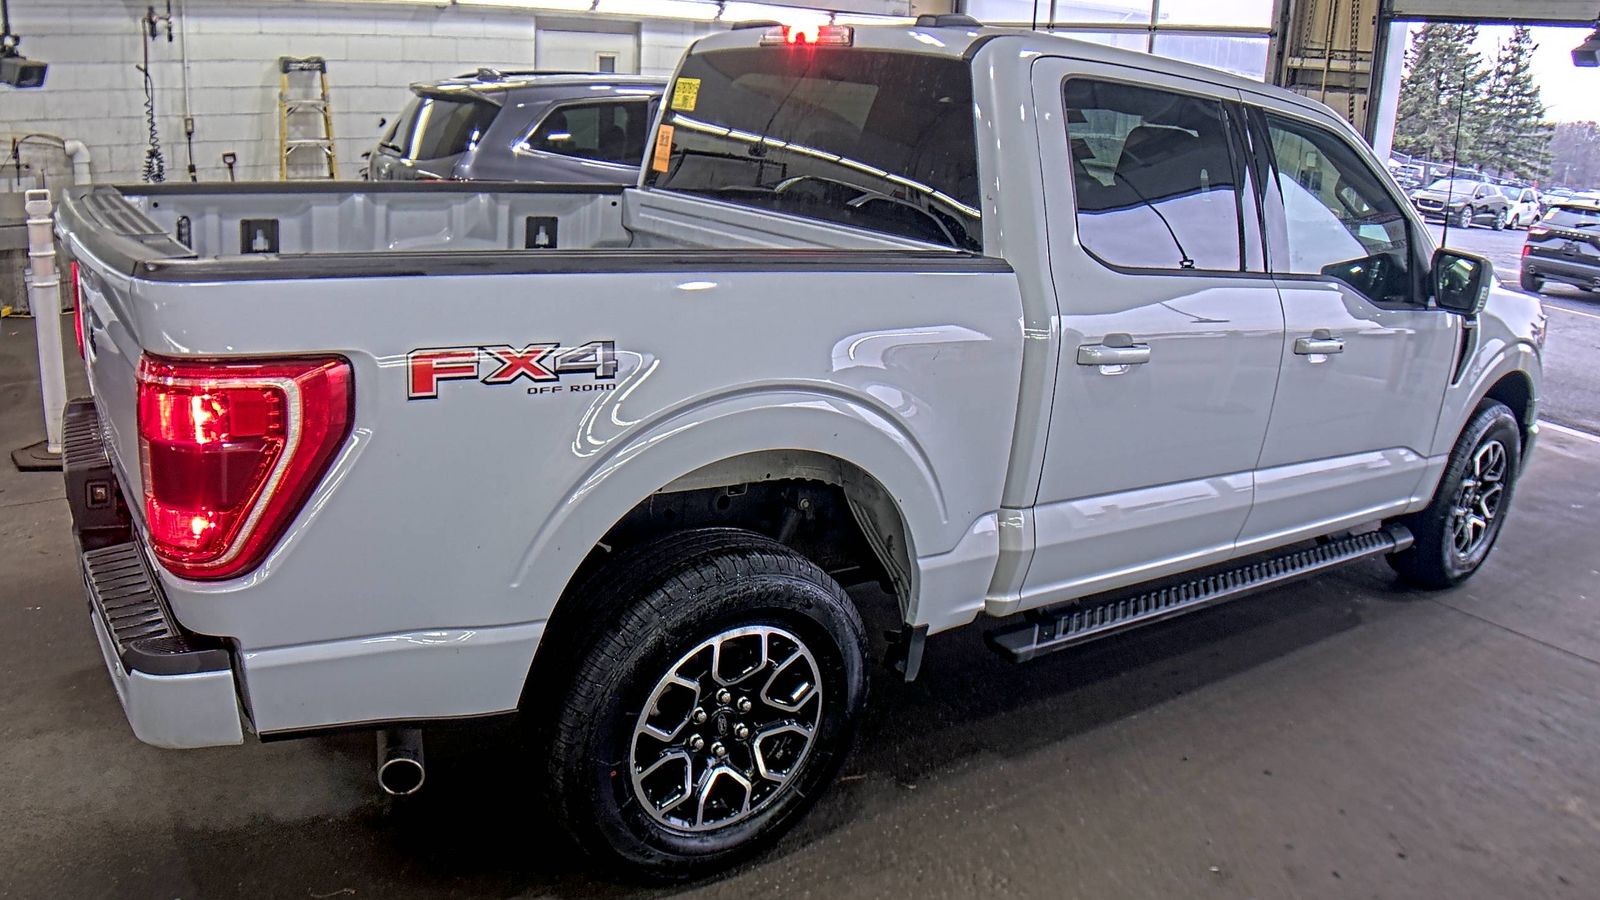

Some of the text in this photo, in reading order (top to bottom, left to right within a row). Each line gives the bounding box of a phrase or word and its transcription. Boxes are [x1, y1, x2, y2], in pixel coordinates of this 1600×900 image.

[407, 340, 618, 400] FX4
[527, 383, 616, 395] OFF ROAD
